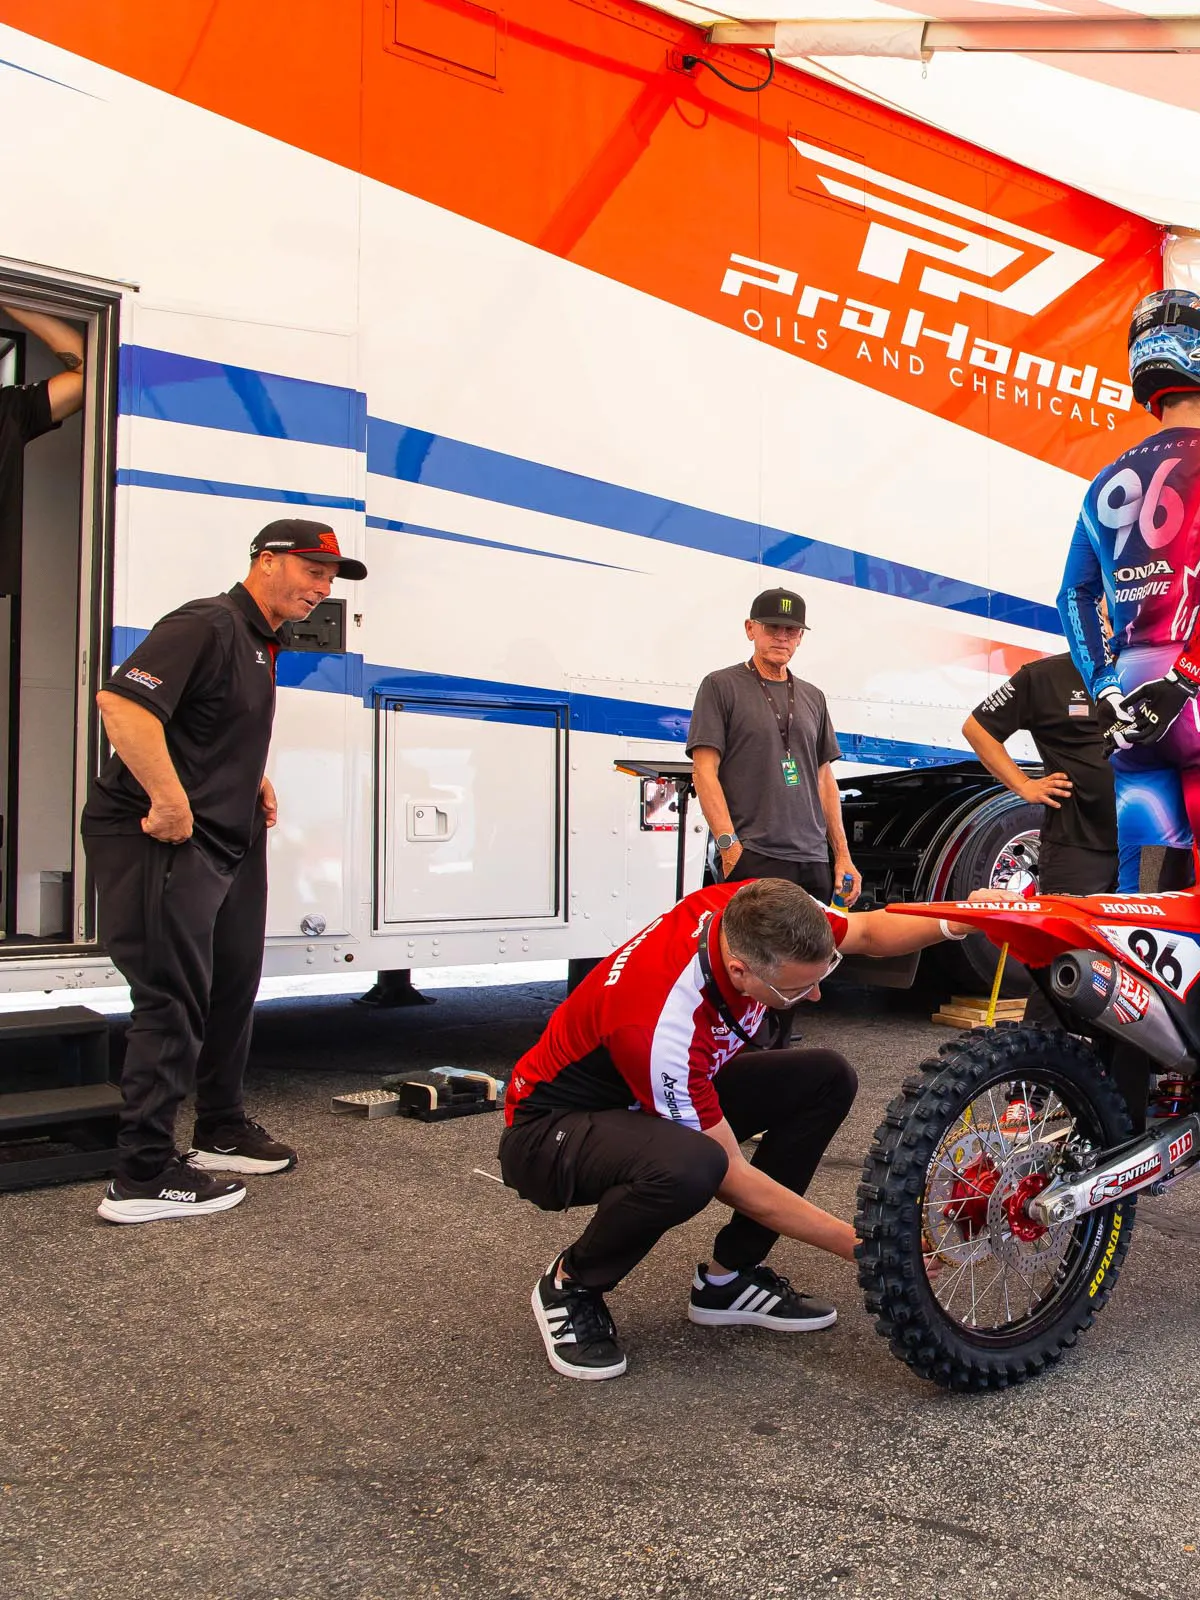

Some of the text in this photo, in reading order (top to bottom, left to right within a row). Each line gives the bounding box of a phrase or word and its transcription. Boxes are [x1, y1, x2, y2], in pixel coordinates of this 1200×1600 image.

[743, 308, 1116, 430] OILS AND CHEMICALS
[1097, 458, 1185, 560] 96
[955, 902, 1041, 912] DUNLOP
[1099, 903, 1166, 916] HONDA
[1128, 929, 1183, 991] 96
[664, 1090, 682, 1121] SHOW
[1168, 1131, 1193, 1164] DID
[159, 1188, 197, 1203] HOKA
[1088, 1212, 1123, 1298] DUNLOP
